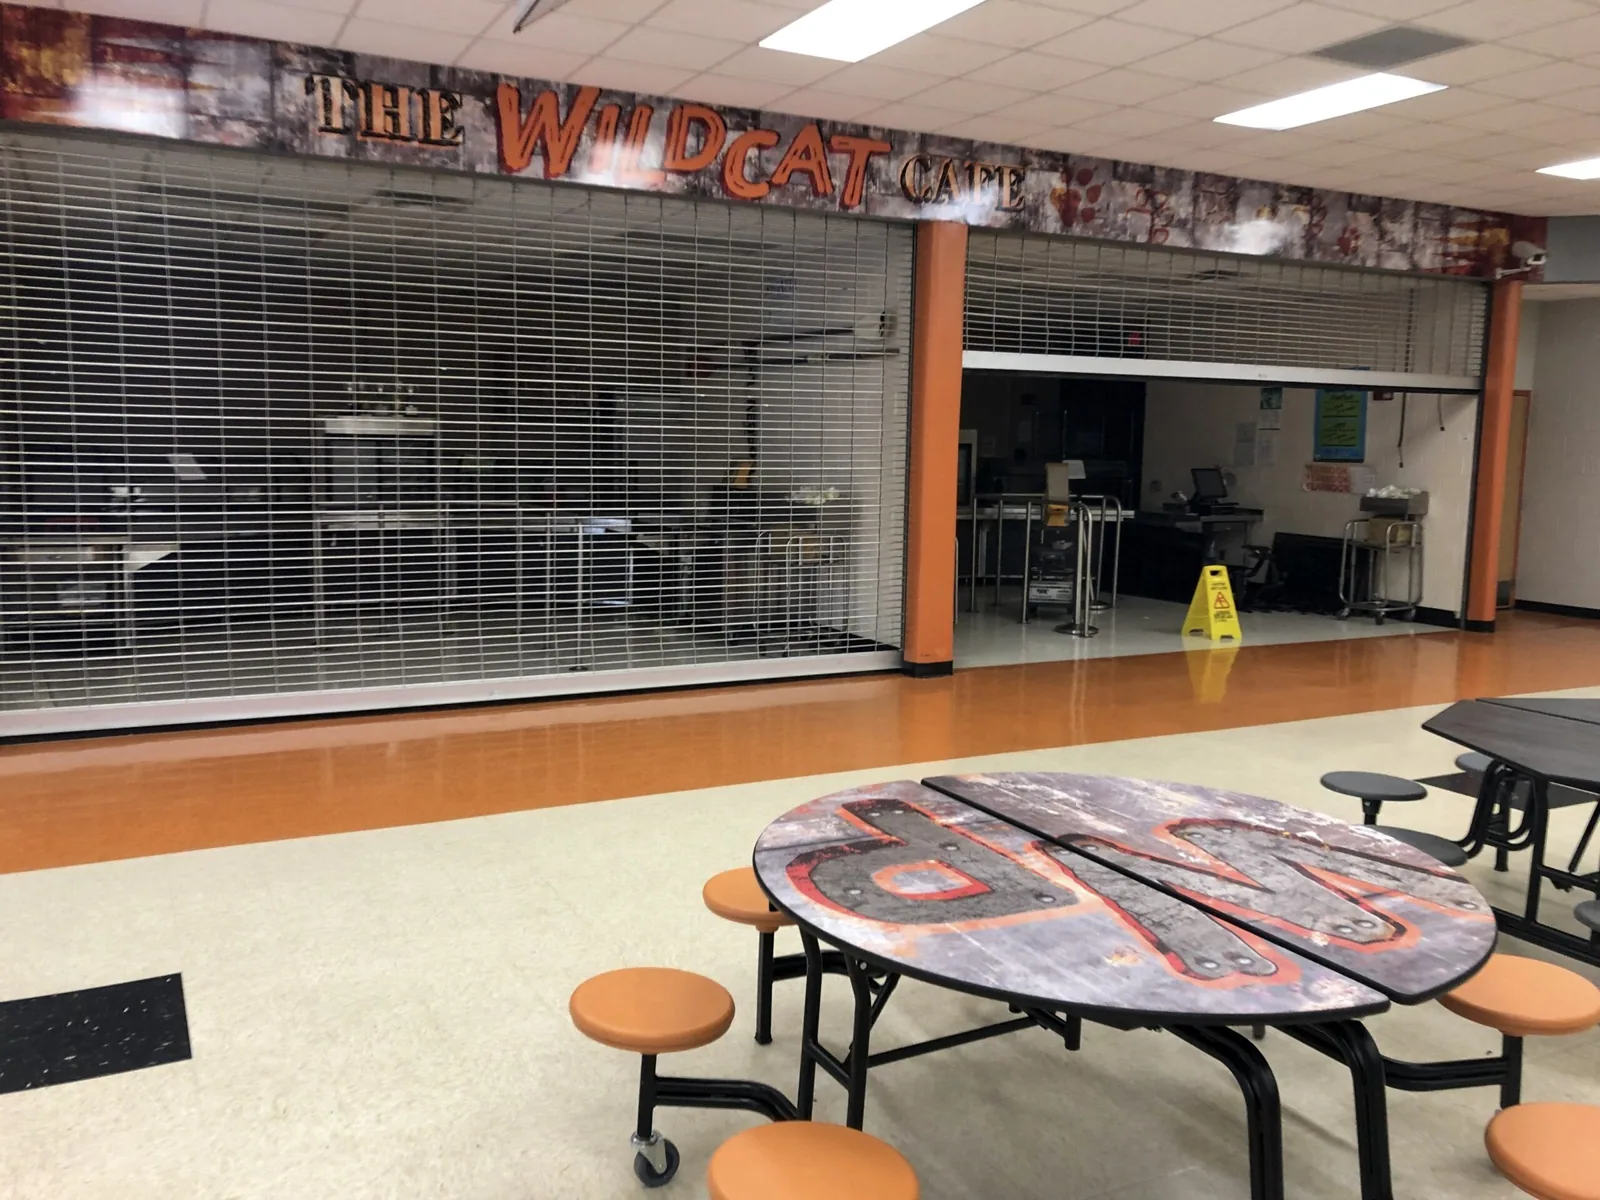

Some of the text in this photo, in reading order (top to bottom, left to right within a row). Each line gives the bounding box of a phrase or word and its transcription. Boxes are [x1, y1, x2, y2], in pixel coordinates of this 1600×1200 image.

[304, 74, 1027, 213] THE WILDCAT CAFE
